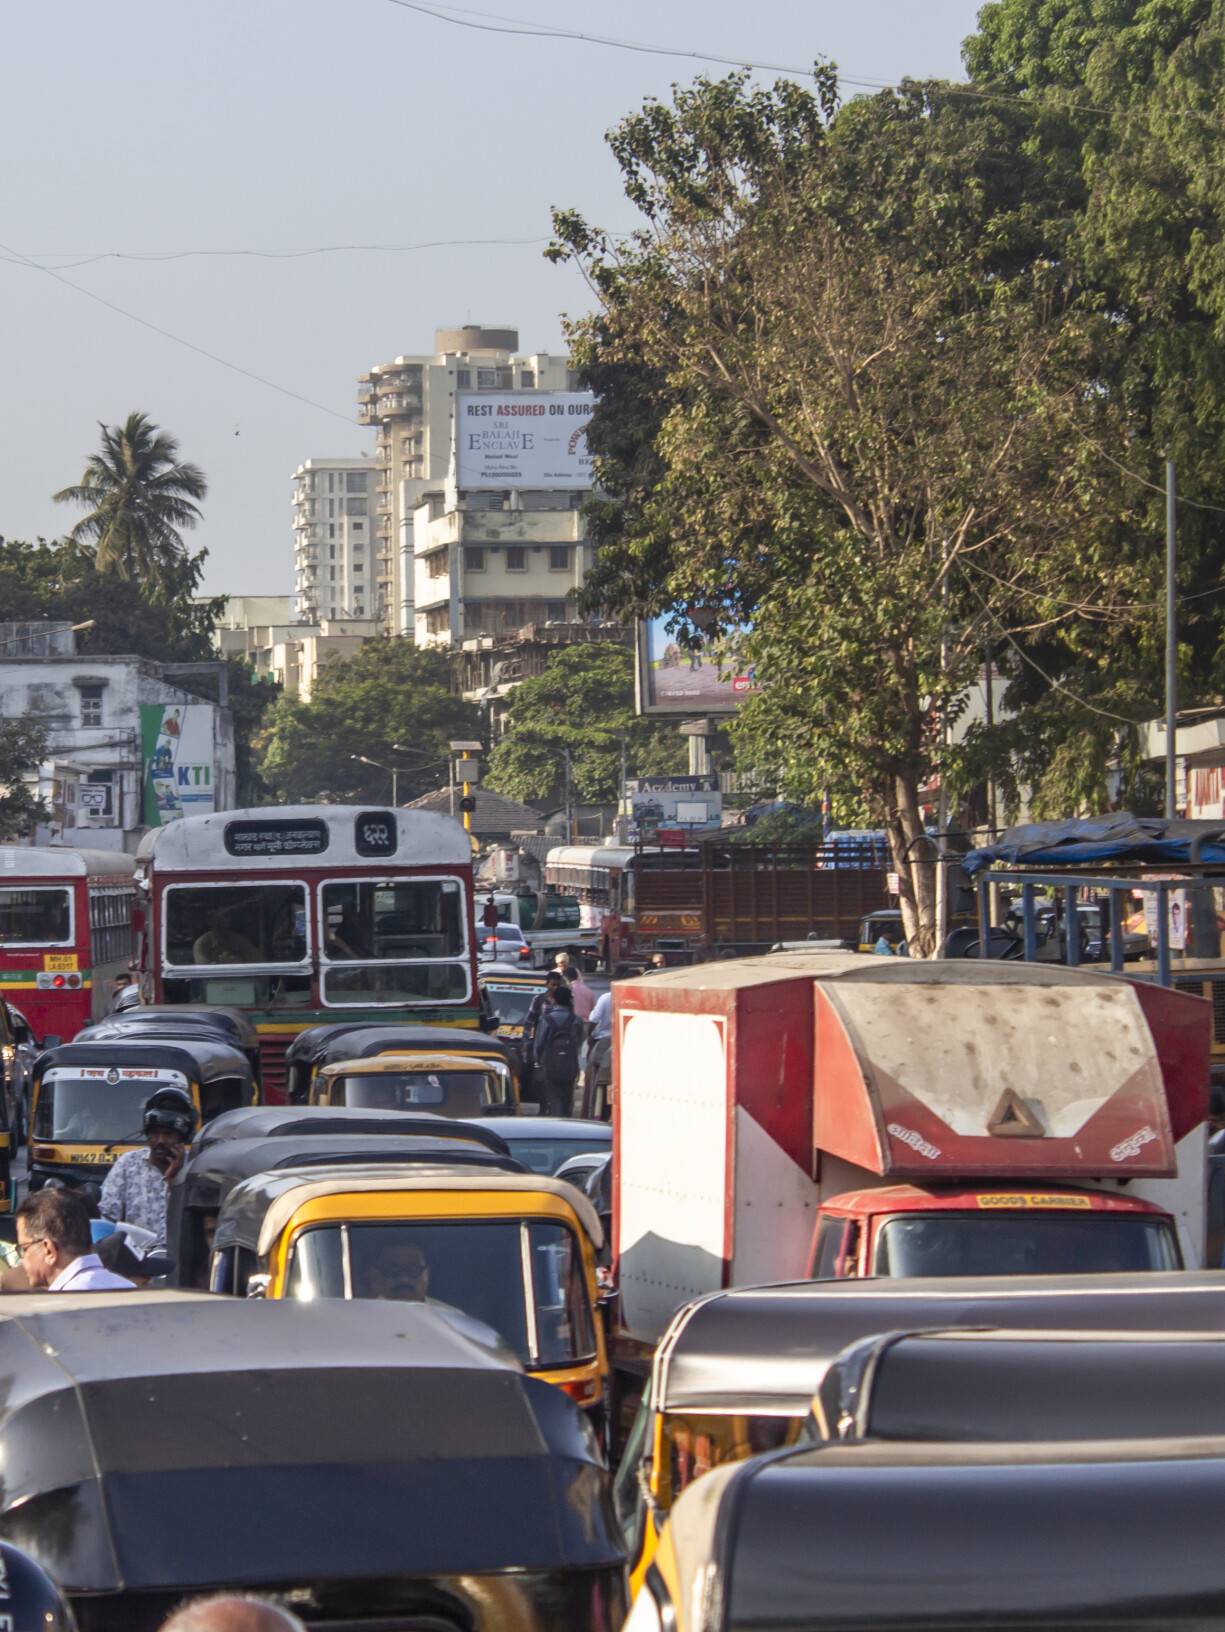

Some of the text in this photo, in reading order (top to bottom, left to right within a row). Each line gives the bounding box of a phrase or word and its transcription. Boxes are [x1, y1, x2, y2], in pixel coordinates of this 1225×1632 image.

[467, 404, 591, 416] REST ASSURED ON OUR
[493, 421, 509, 429] SRI
[482, 430, 520, 440] BALAJI
[468, 433, 535, 450] ENCLAVE
[178, 766, 211, 786] KTI
[980, 1195, 1089, 1206] GOODS CARRIER
